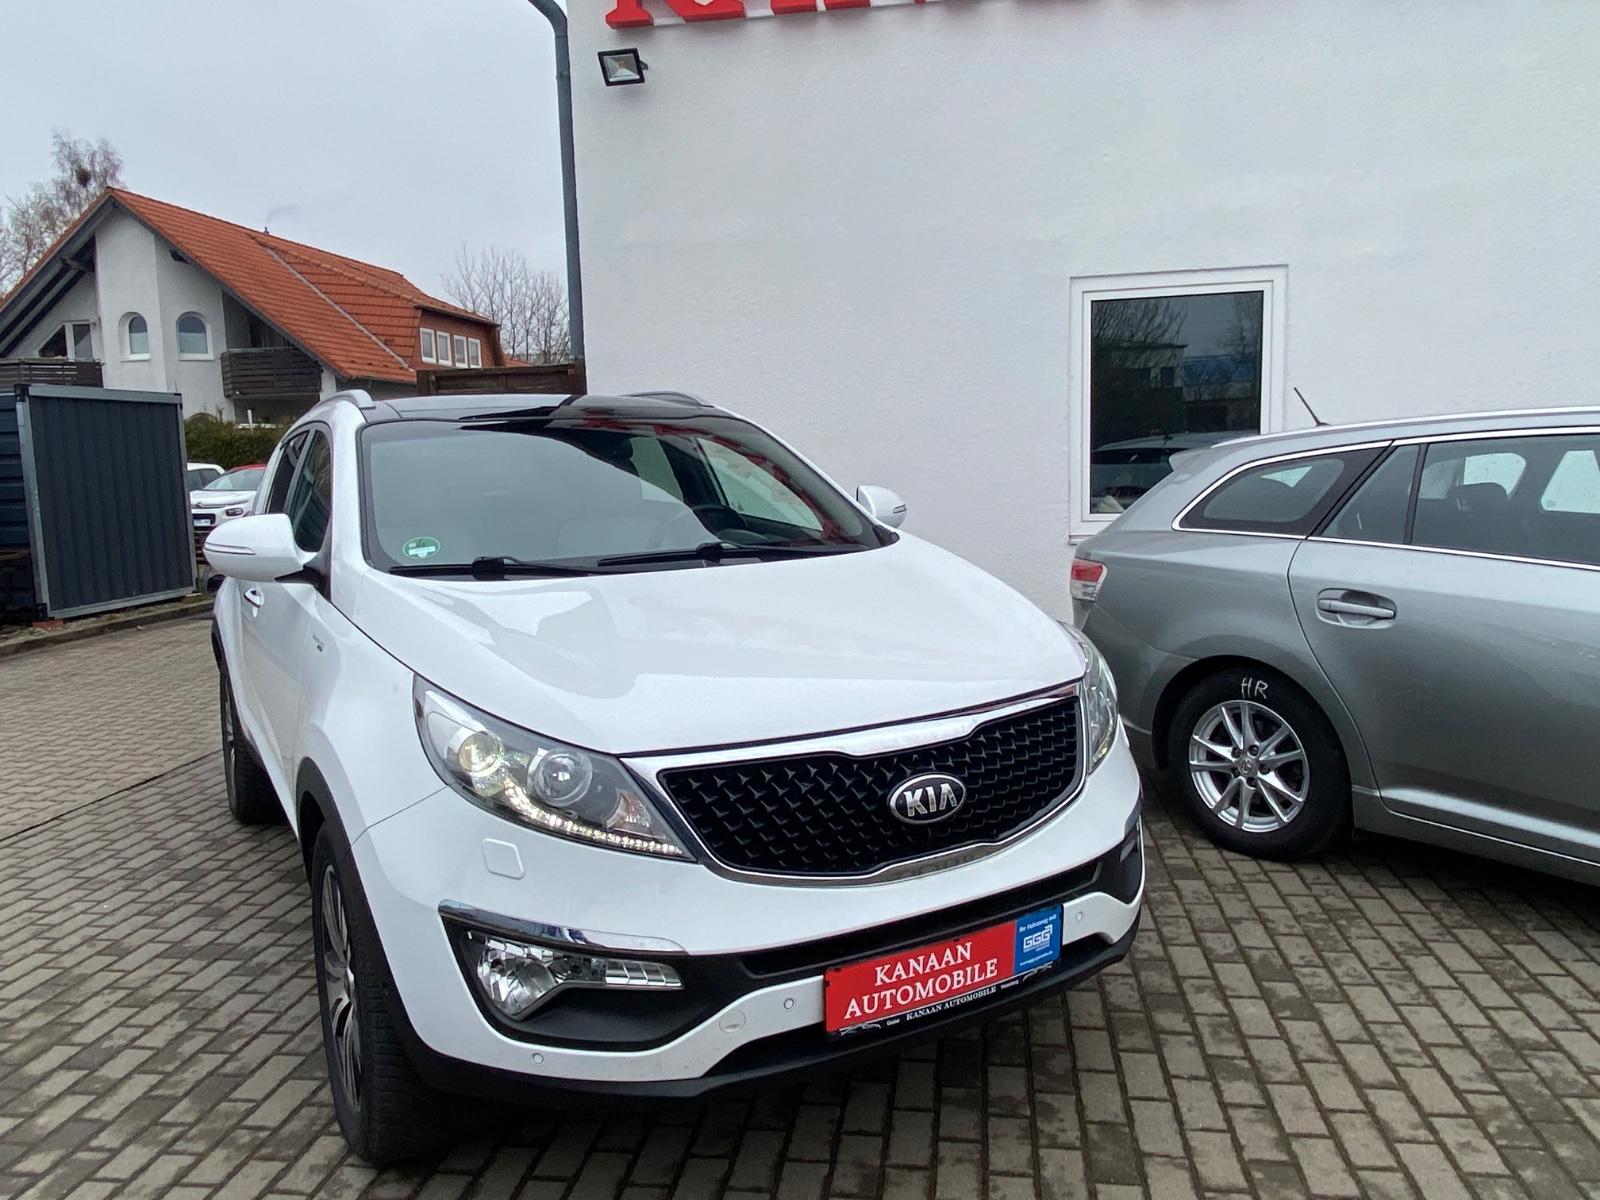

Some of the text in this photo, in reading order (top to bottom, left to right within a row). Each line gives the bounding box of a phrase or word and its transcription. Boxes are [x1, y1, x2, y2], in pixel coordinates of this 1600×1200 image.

[1240, 676, 1269, 700] HR
[903, 782, 958, 817] KIA
[1023, 928, 1051, 949] GGG
[874, 942, 973, 987] KANAAN
[843, 958, 998, 1020] AUTOMOBILE
[905, 1003, 943, 1021] KANAAN
[943, 985, 997, 1010] AUTOMOBILE
